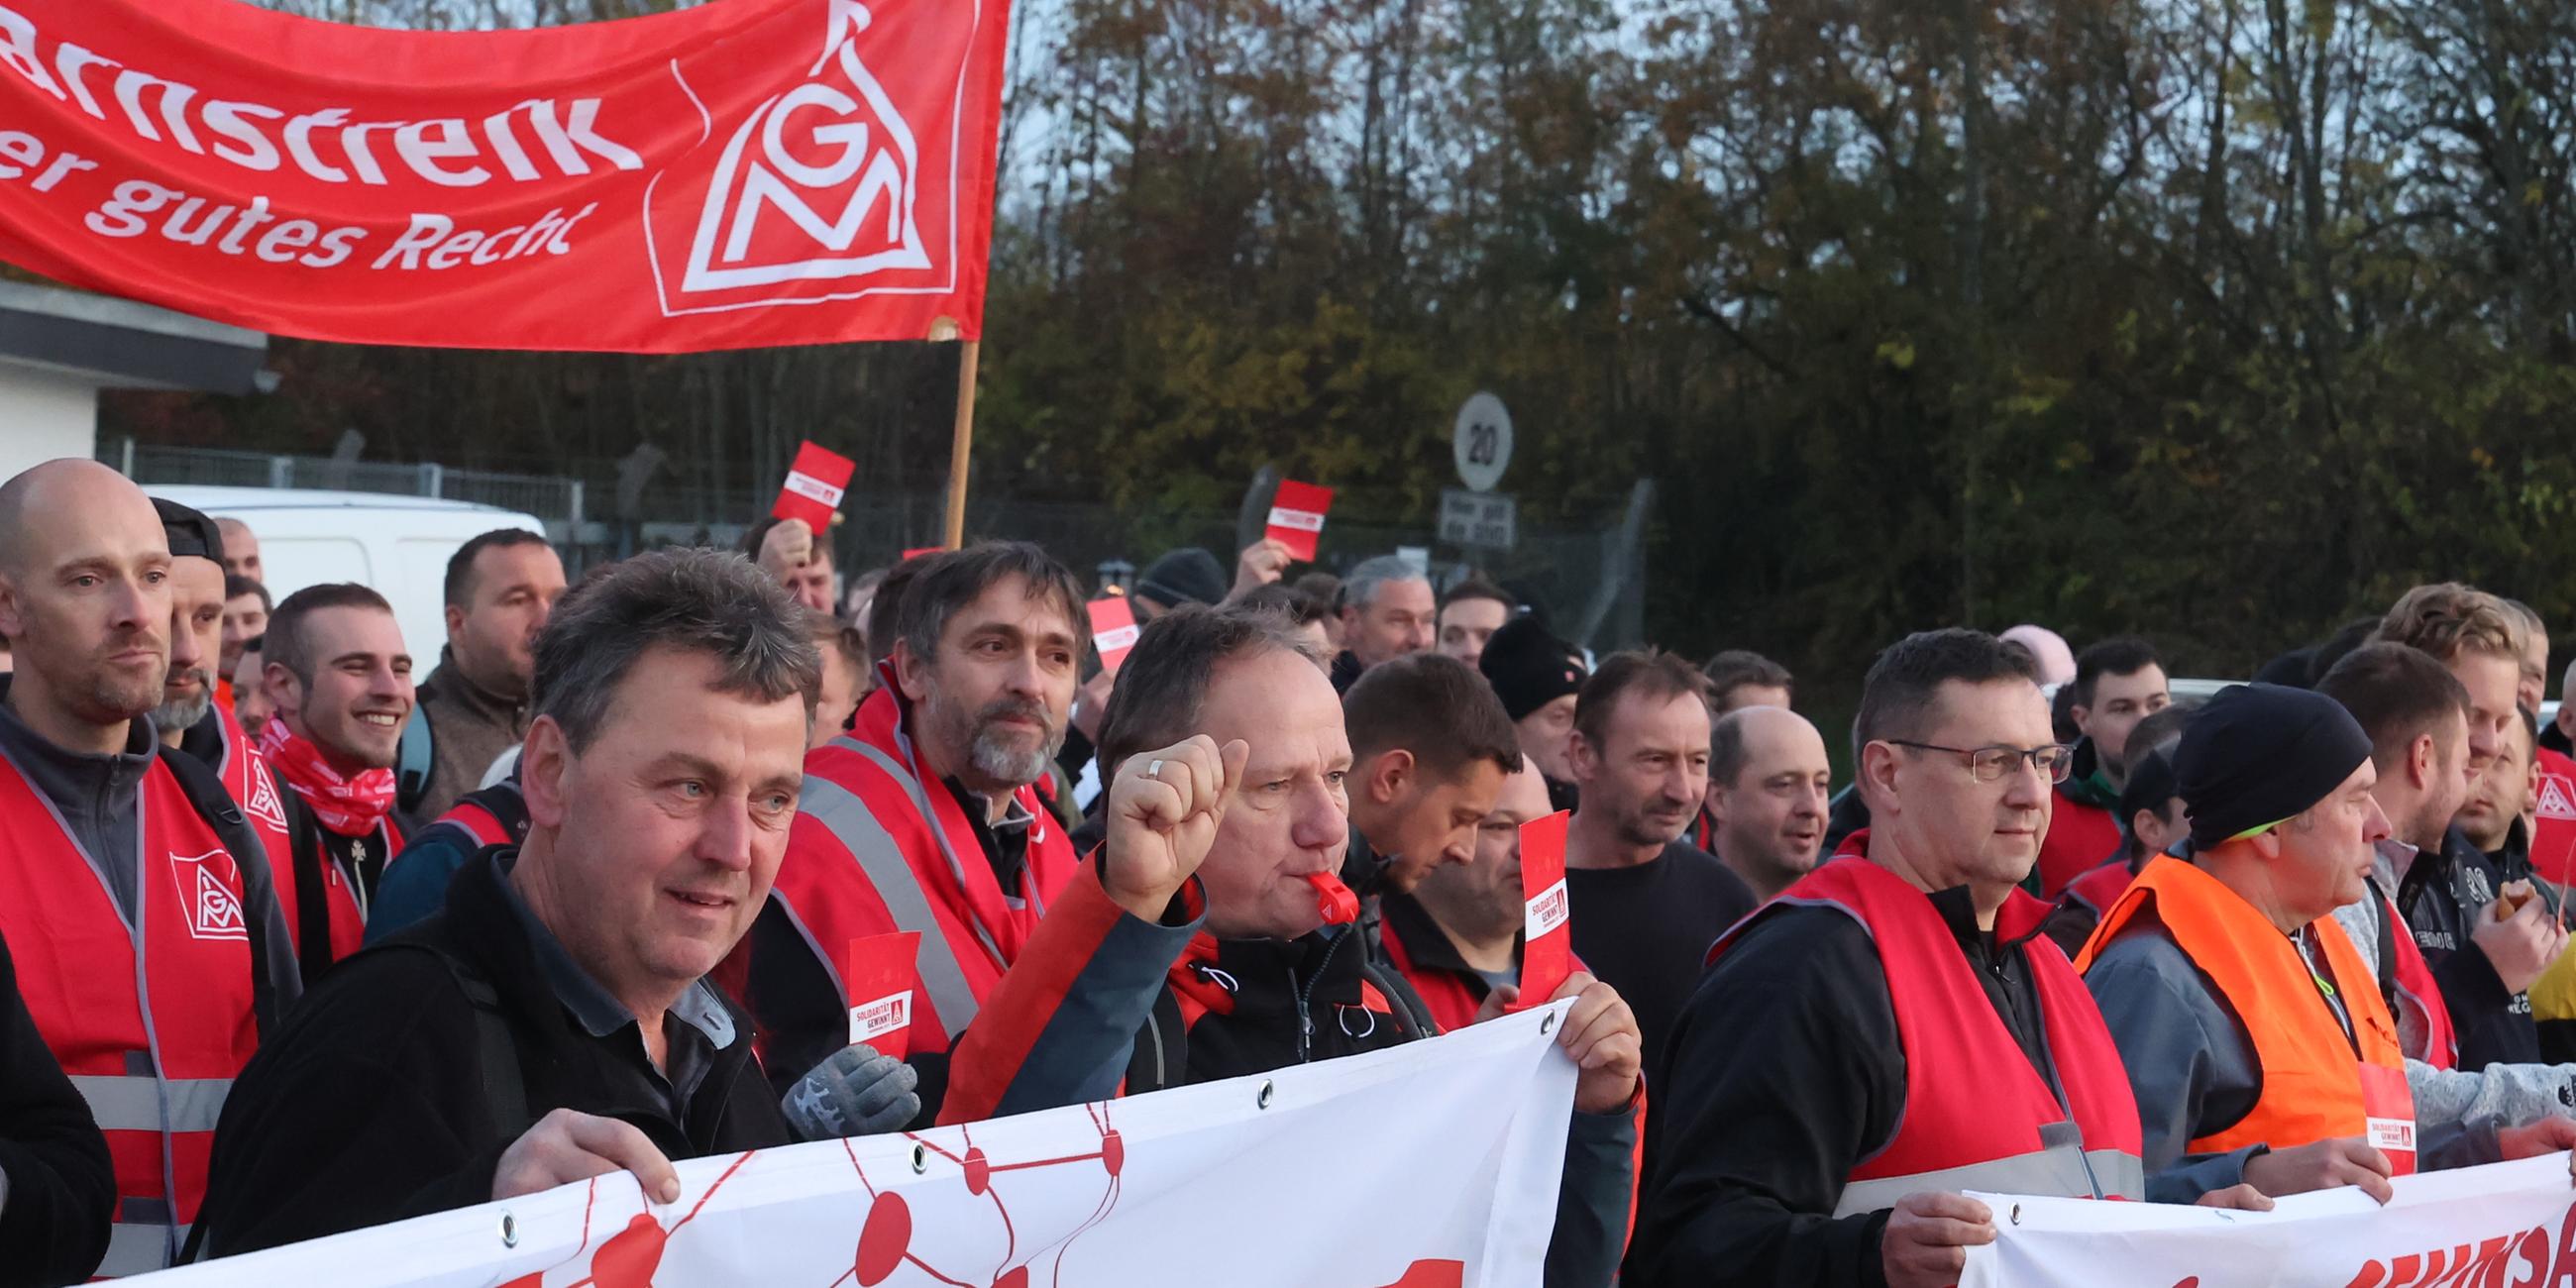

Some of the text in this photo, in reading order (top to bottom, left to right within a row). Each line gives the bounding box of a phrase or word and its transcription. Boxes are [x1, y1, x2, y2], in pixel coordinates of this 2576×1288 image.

[84, 180, 368, 268] gutes
[371, 201, 598, 269] Recht
[1468, 423, 1498, 466] 20
[202, 876, 245, 926] IGM
[857, 1002, 890, 1021] SOLIDARITÄT
[868, 1013, 890, 1028] GEWINNT
